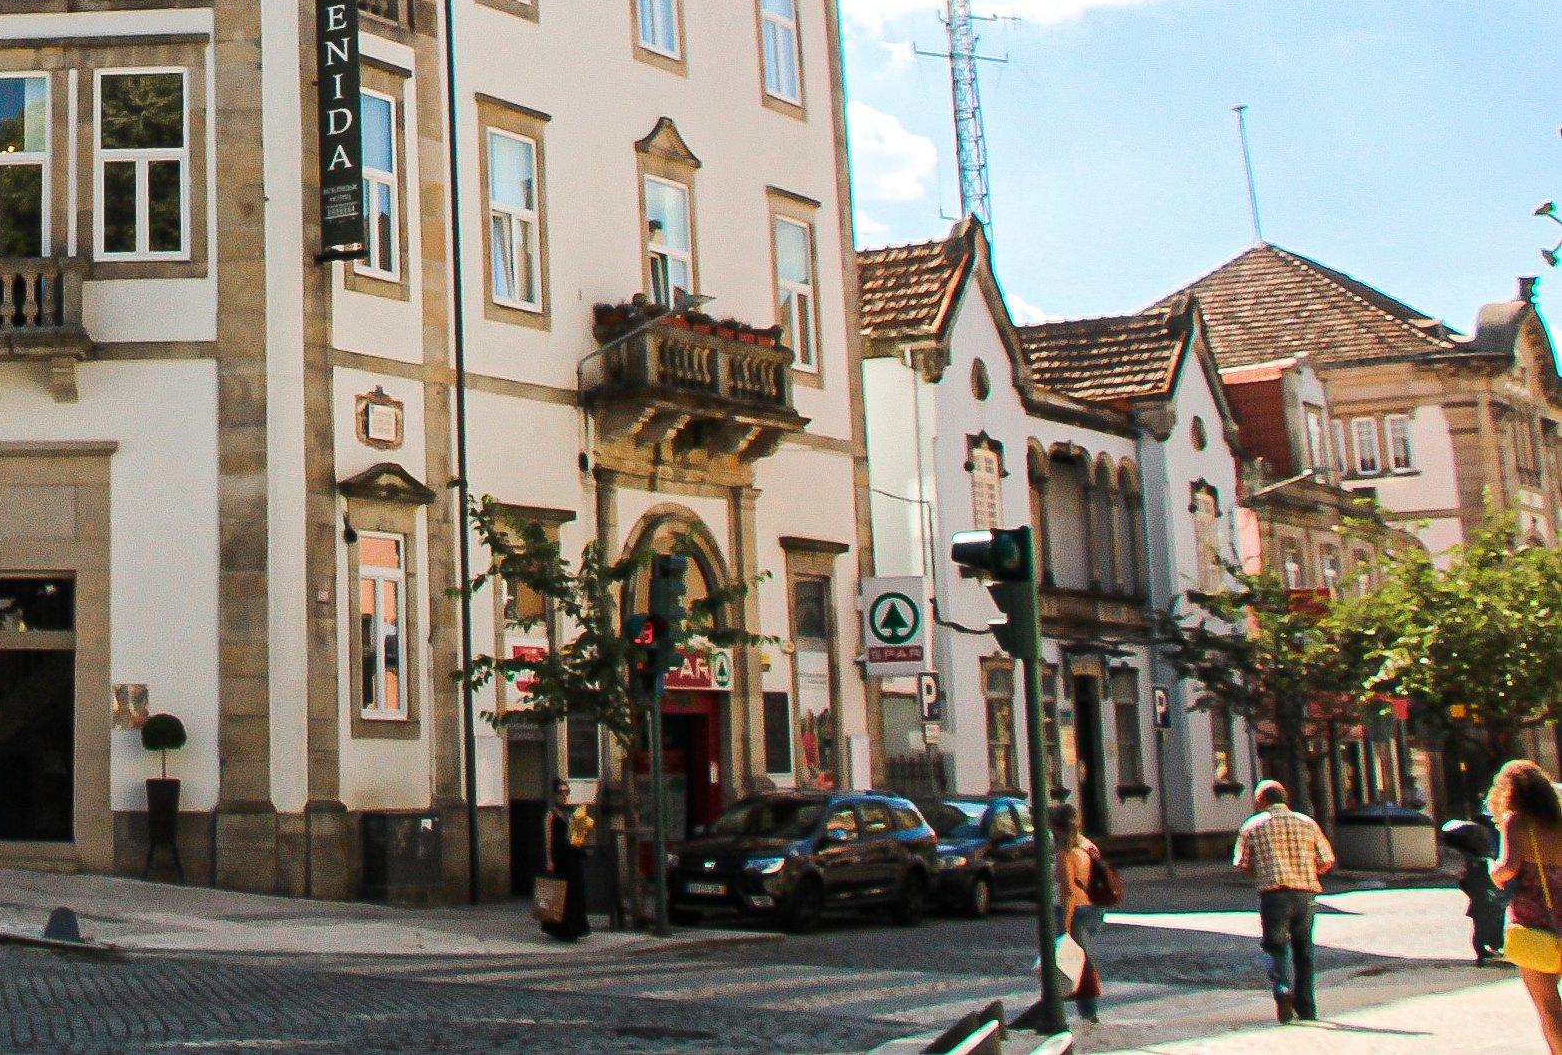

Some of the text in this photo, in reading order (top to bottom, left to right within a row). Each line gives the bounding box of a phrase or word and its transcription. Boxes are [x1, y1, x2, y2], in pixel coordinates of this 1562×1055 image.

[871, 648, 922, 661] SPAR
[922, 676, 938, 717] P
[1155, 689, 1168, 724] P
